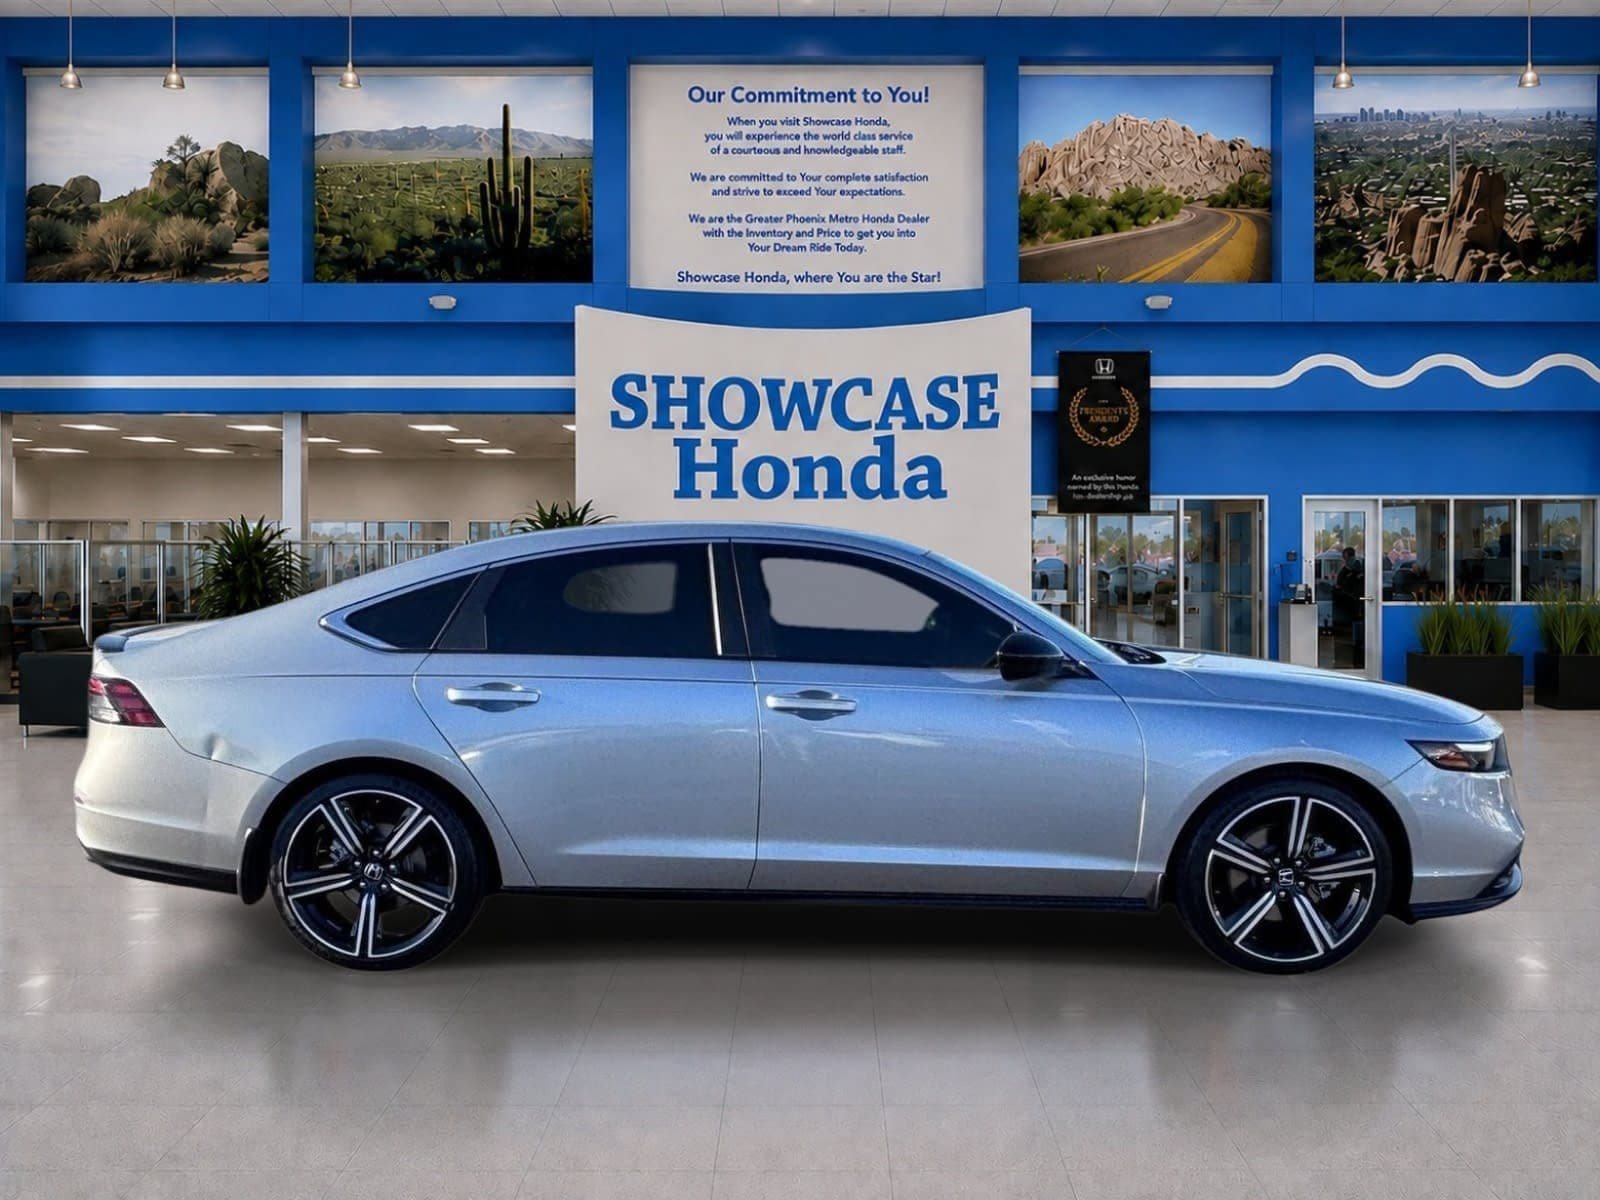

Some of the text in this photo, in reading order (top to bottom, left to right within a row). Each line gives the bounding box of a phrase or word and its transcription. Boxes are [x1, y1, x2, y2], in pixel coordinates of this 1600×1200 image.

[687, 85, 930, 105] Our Commitment to You!
[726, 115, 891, 129] When you visit Showcase Honda,
[704, 130, 914, 144] you will experience the world class service
[709, 143, 721, 155] of
[722, 147, 730, 155] a
[730, 146, 782, 156] courteous
[782, 144, 802, 155] and
[881, 143, 906, 155] staff.
[689, 171, 929, 185] We are committed to Your complete satisfaction
[711, 185, 906, 200] and strive to exceed Your expectations.
[688, 213, 930, 225] We are the Greater Phoenix Metro Honda Dealer
[702, 226, 917, 241] with the Inventory and Price to get you into
[747, 242, 868, 255] Your Dream Ride Today.
[676, 270, 941, 286] Showcase Honda, where You are the Star!
[610, 373, 1001, 432] SHOWCASE
[672, 434, 948, 500] Honda
